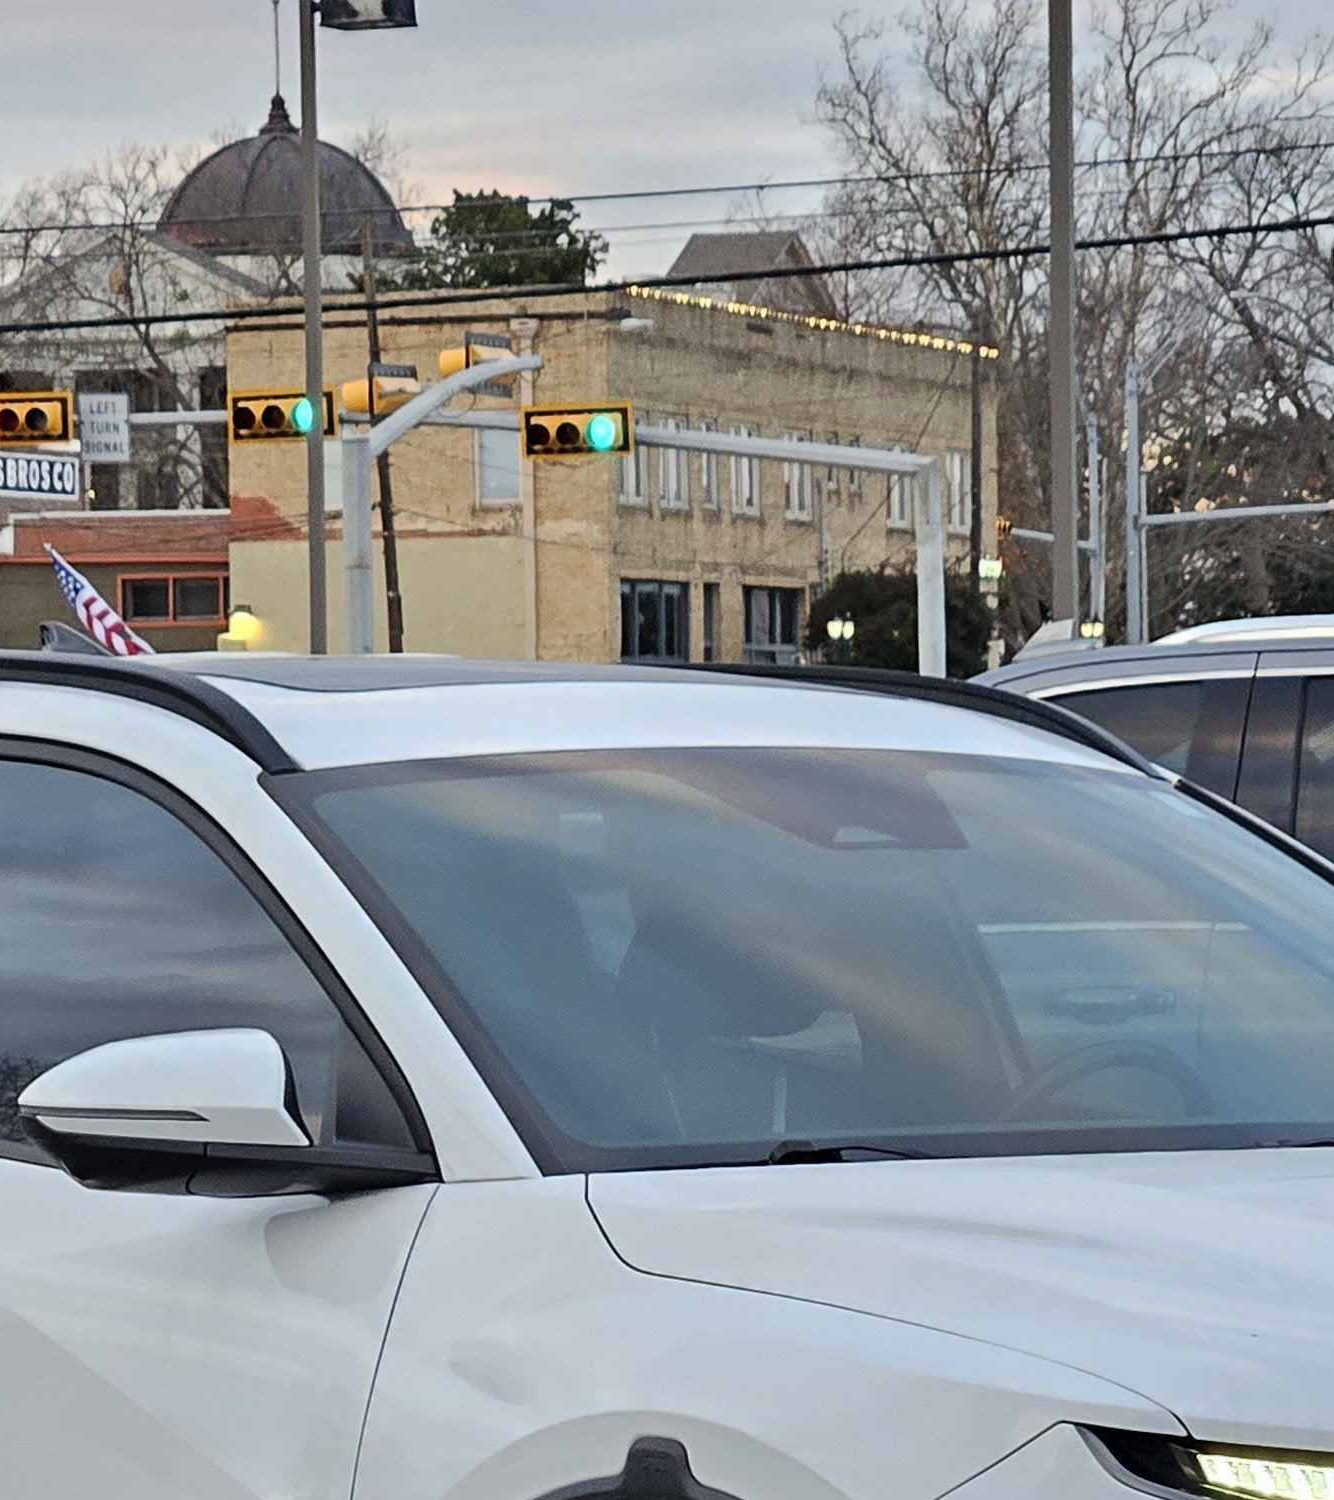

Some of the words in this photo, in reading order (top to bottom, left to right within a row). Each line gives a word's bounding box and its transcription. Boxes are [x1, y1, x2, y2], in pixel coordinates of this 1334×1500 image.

[89, 401, 117, 415] LEFT
[88, 420, 120, 434] TURN
[84, 440, 126, 454] SIGNAL
